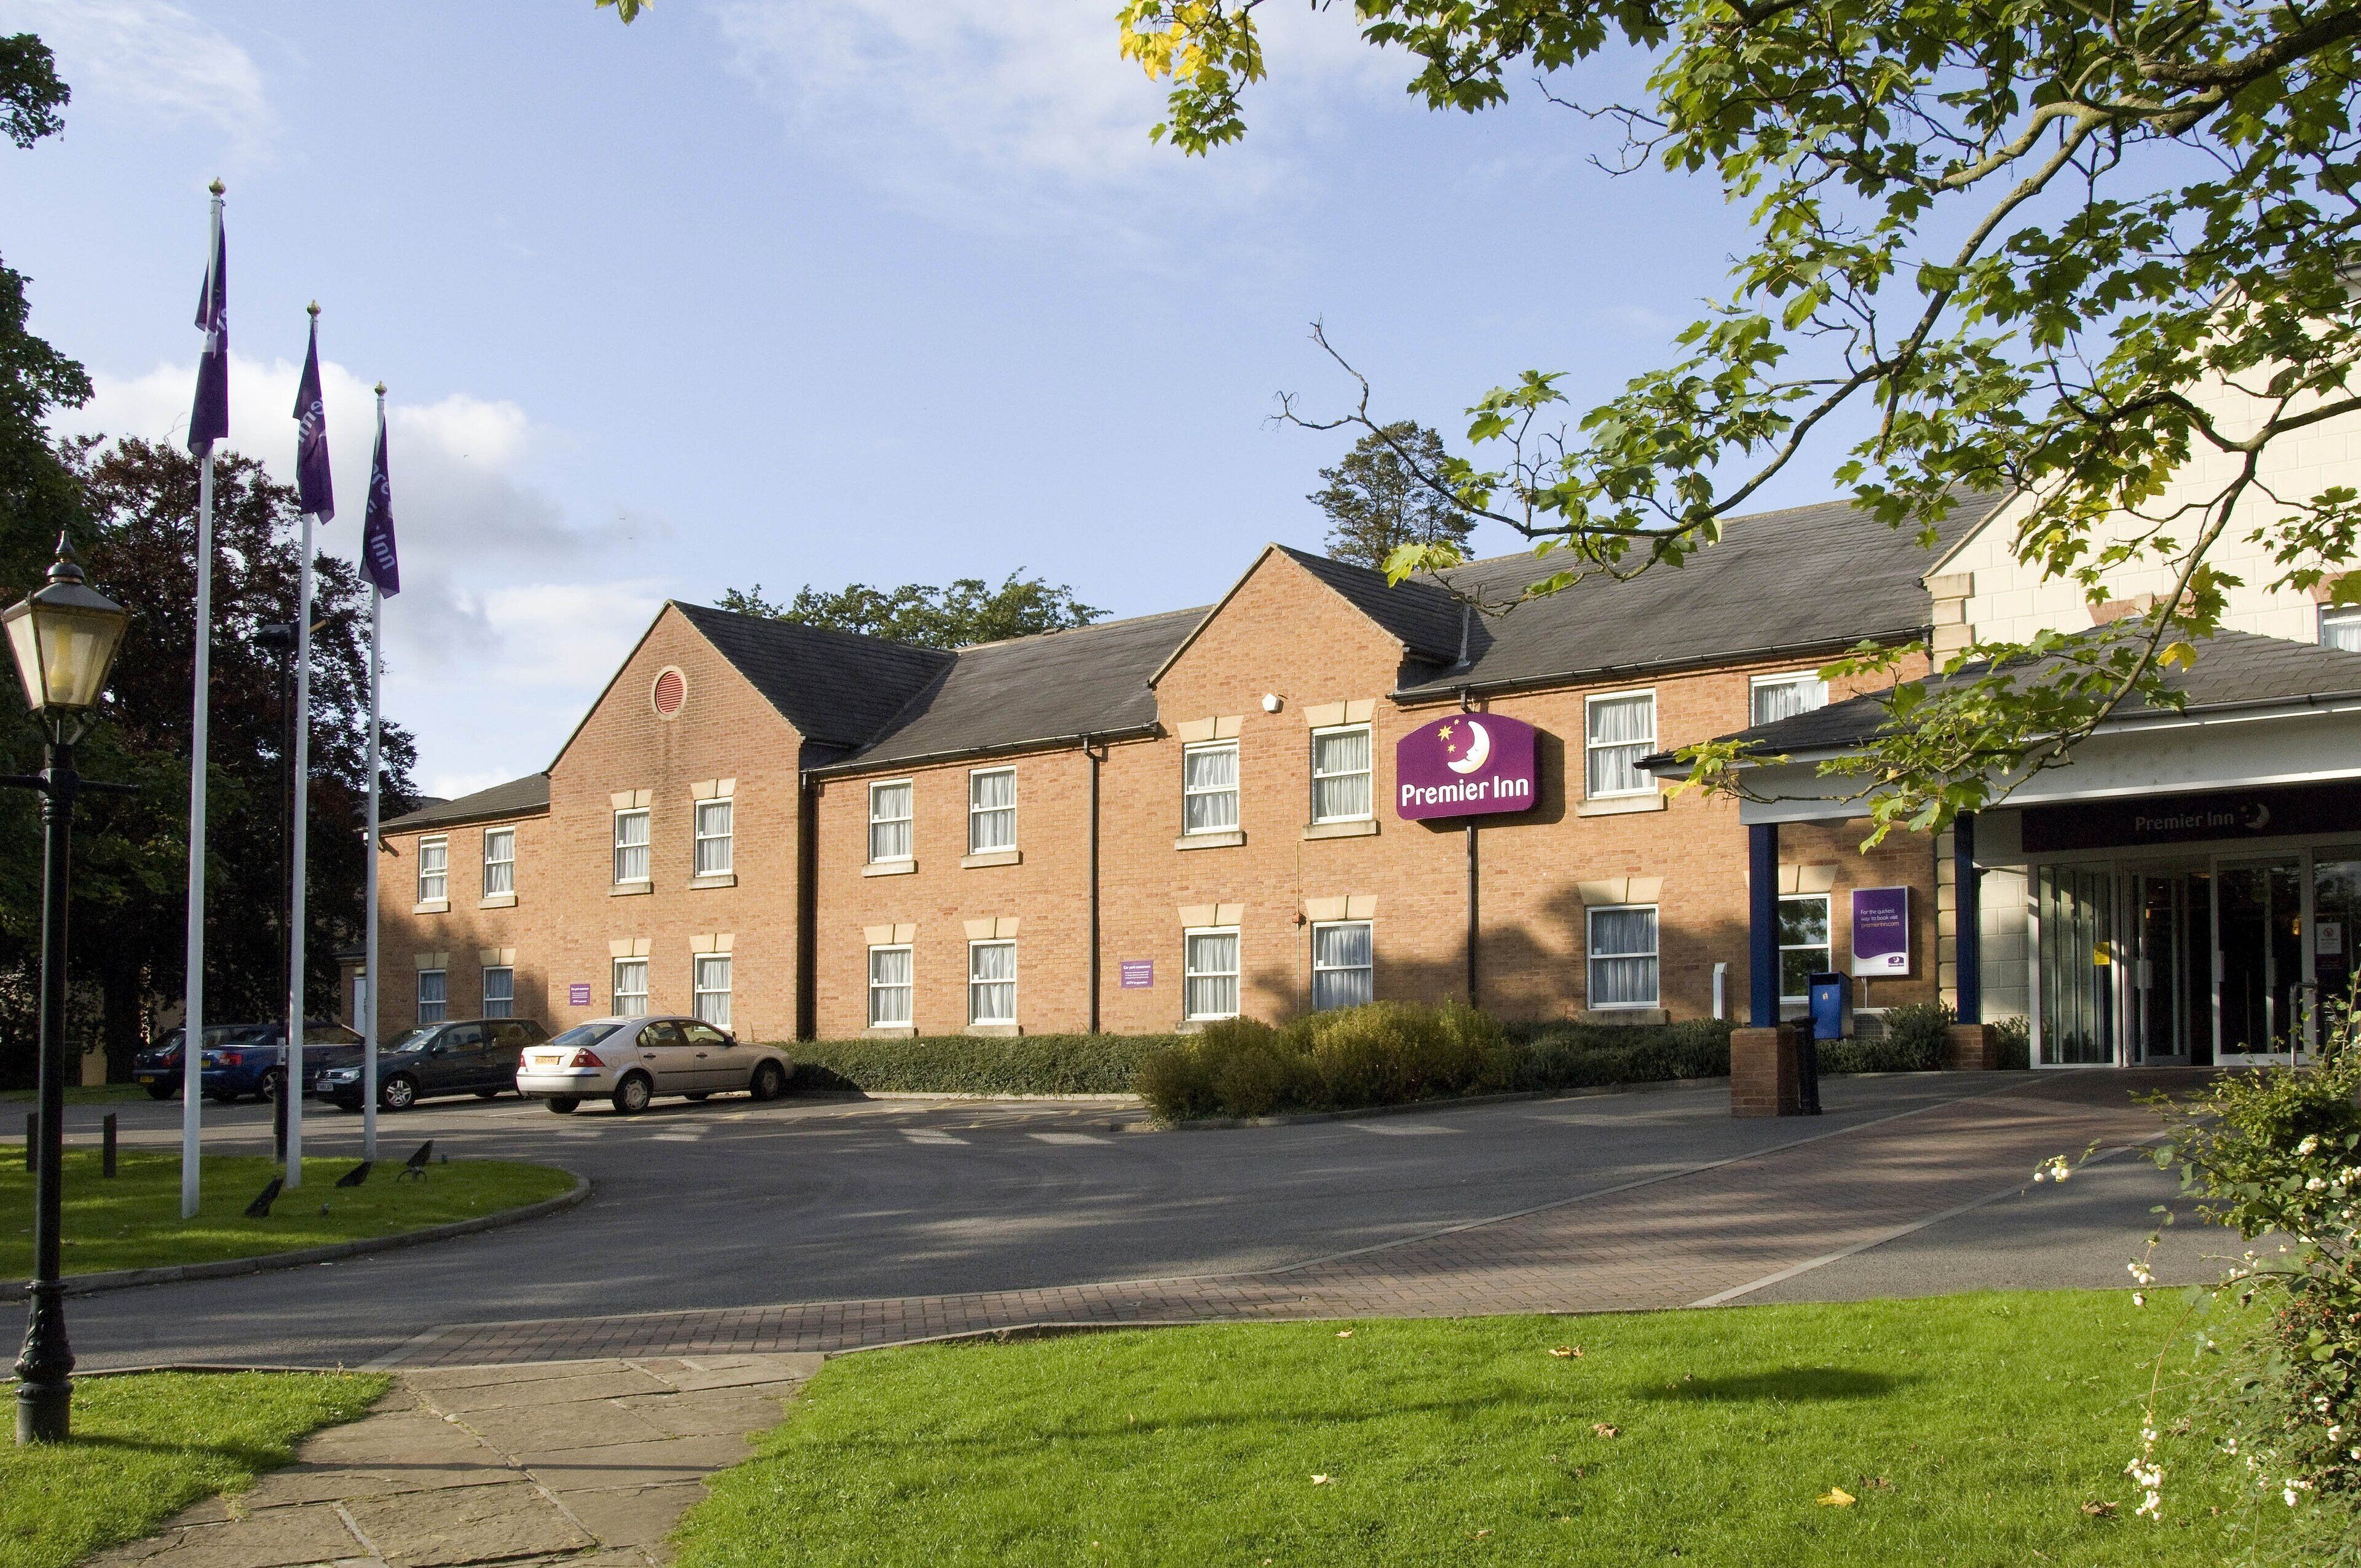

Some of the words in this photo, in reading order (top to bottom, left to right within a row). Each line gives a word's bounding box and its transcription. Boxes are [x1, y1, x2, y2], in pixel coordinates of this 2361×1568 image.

[1402, 778, 1489, 807] Premier
[1493, 775, 1529, 798] Inn
[2135, 814, 2203, 831] Premier
[2207, 811, 2234, 826] Inn
